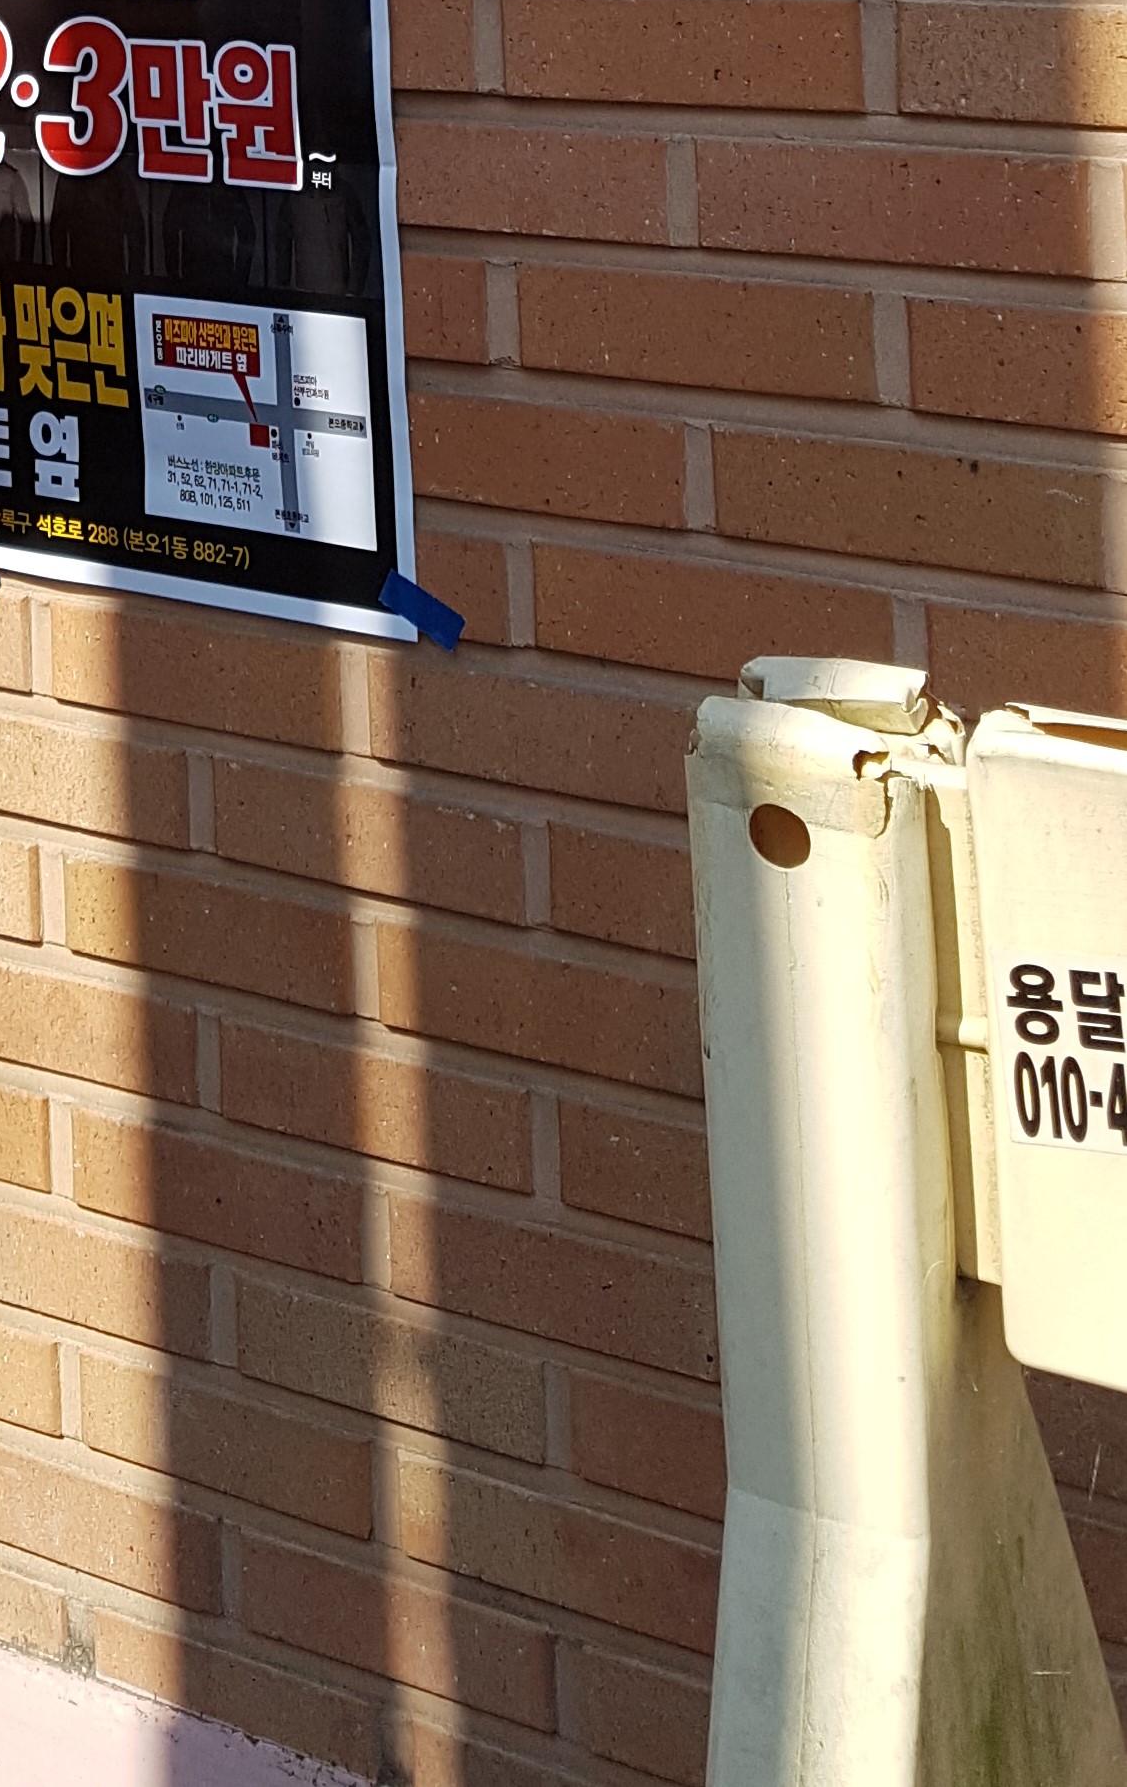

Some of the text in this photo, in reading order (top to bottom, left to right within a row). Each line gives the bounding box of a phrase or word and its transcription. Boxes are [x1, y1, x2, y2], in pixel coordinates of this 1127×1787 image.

[310, 170, 333, 190] 부터
[13, 284, 130, 408] 맞은편
[164, 318, 258, 353] 미즈피아 산부인과 맞은편
[176, 346, 233, 371] 파리바게트
[29, 410, 80, 503] 옆
[36, 513, 85, 541] 석호로
[88, 523, 119, 547] 288
[123, 528, 189, 560] (본오1동
[193, 540, 250, 570] 882-7)
[1006, 964, 1127, 1053] 용달
